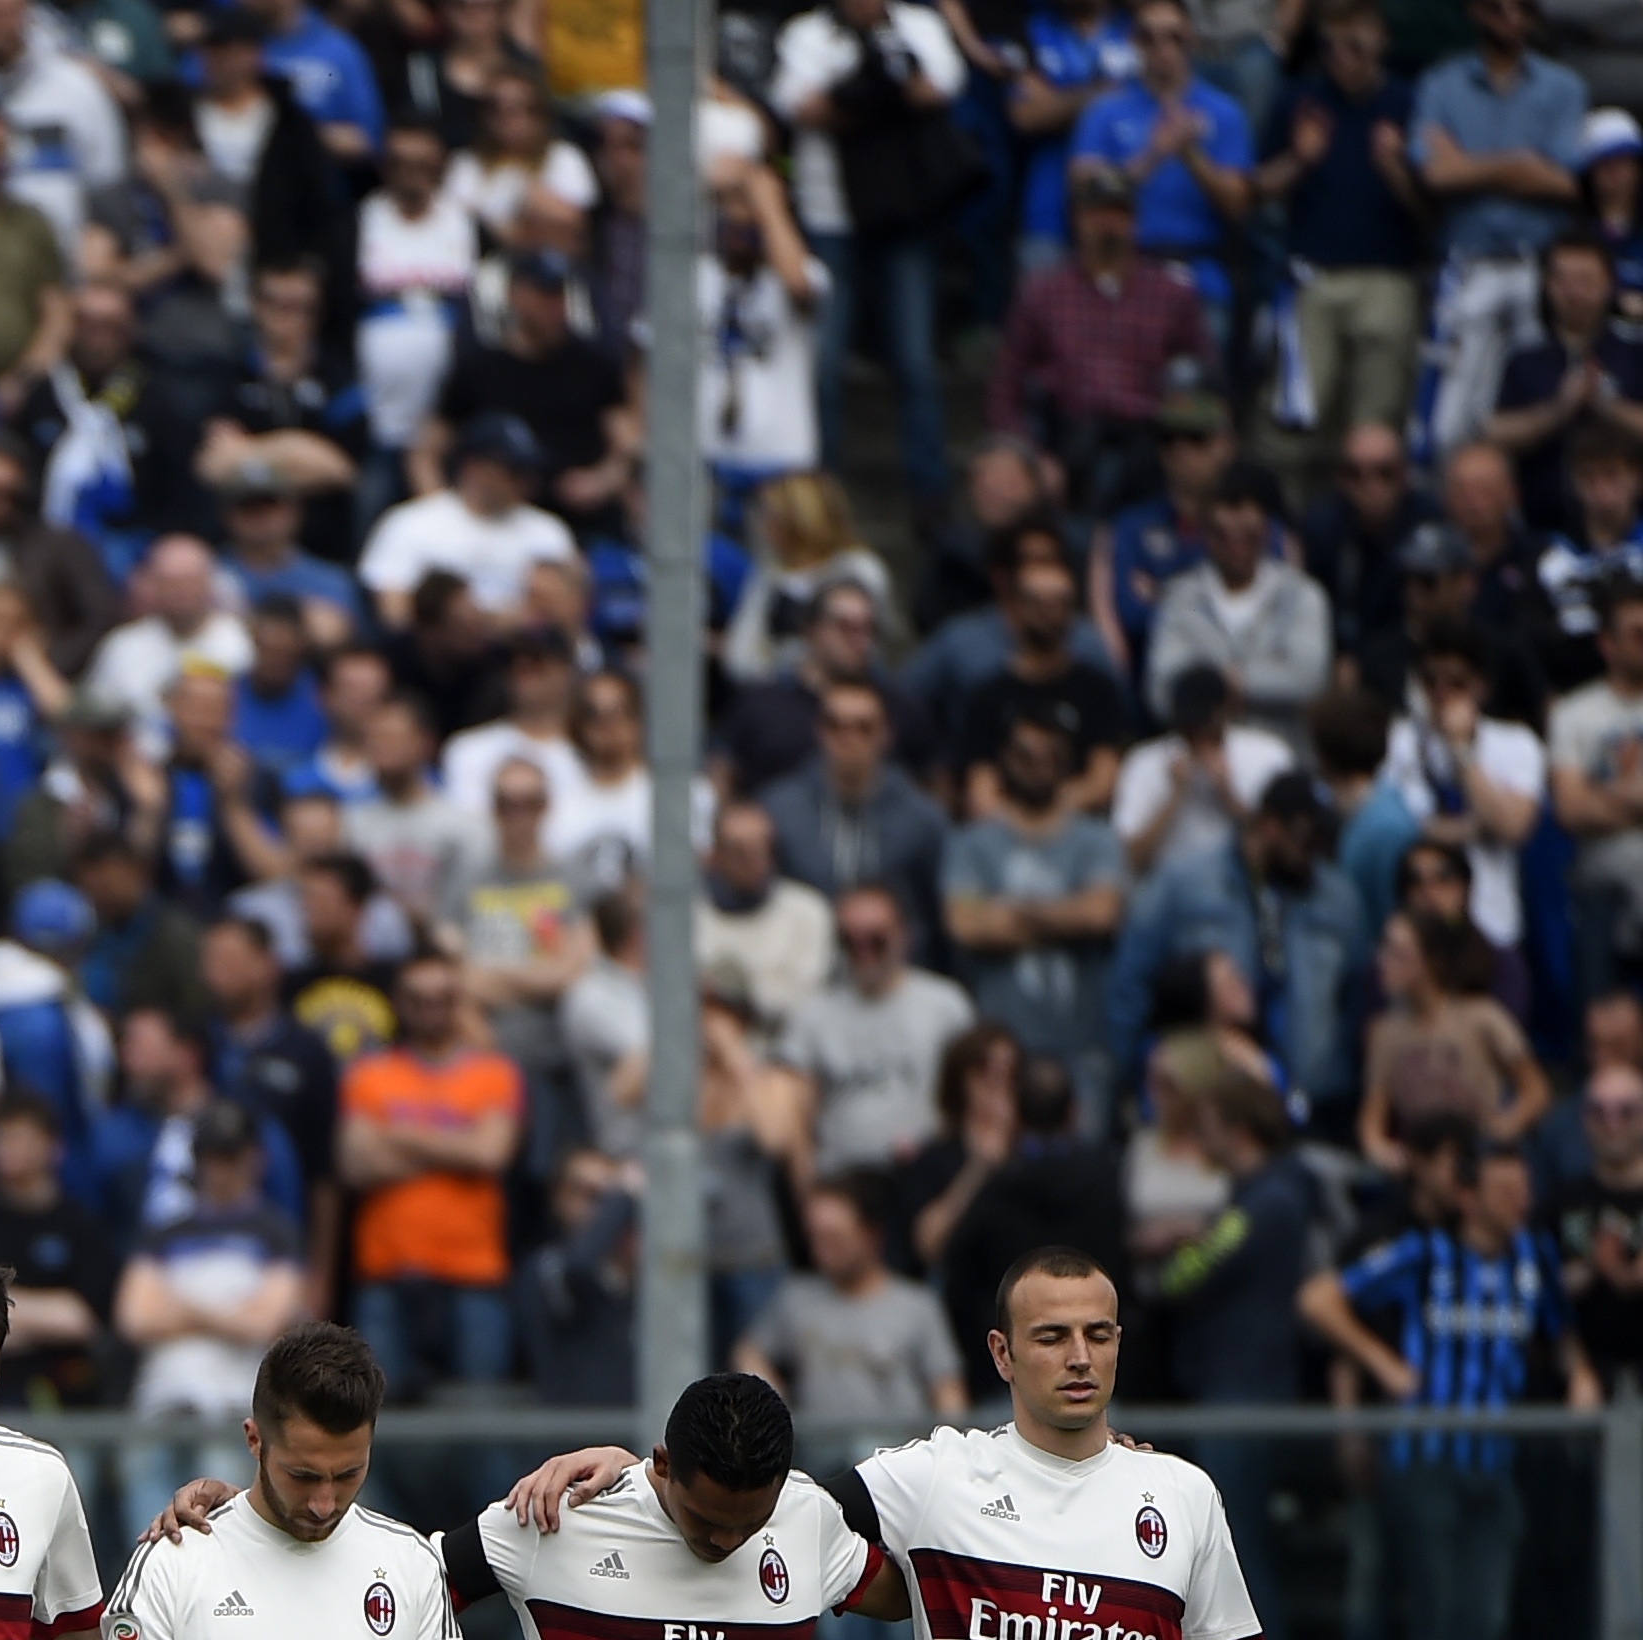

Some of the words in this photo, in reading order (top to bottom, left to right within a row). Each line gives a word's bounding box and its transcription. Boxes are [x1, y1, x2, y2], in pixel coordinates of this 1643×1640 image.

[980, 1506, 1021, 1522] adidas
[590, 1567, 630, 1580] adidas
[1042, 1572, 1102, 1615] Fly
[213, 1606, 255, 1617] adidas
